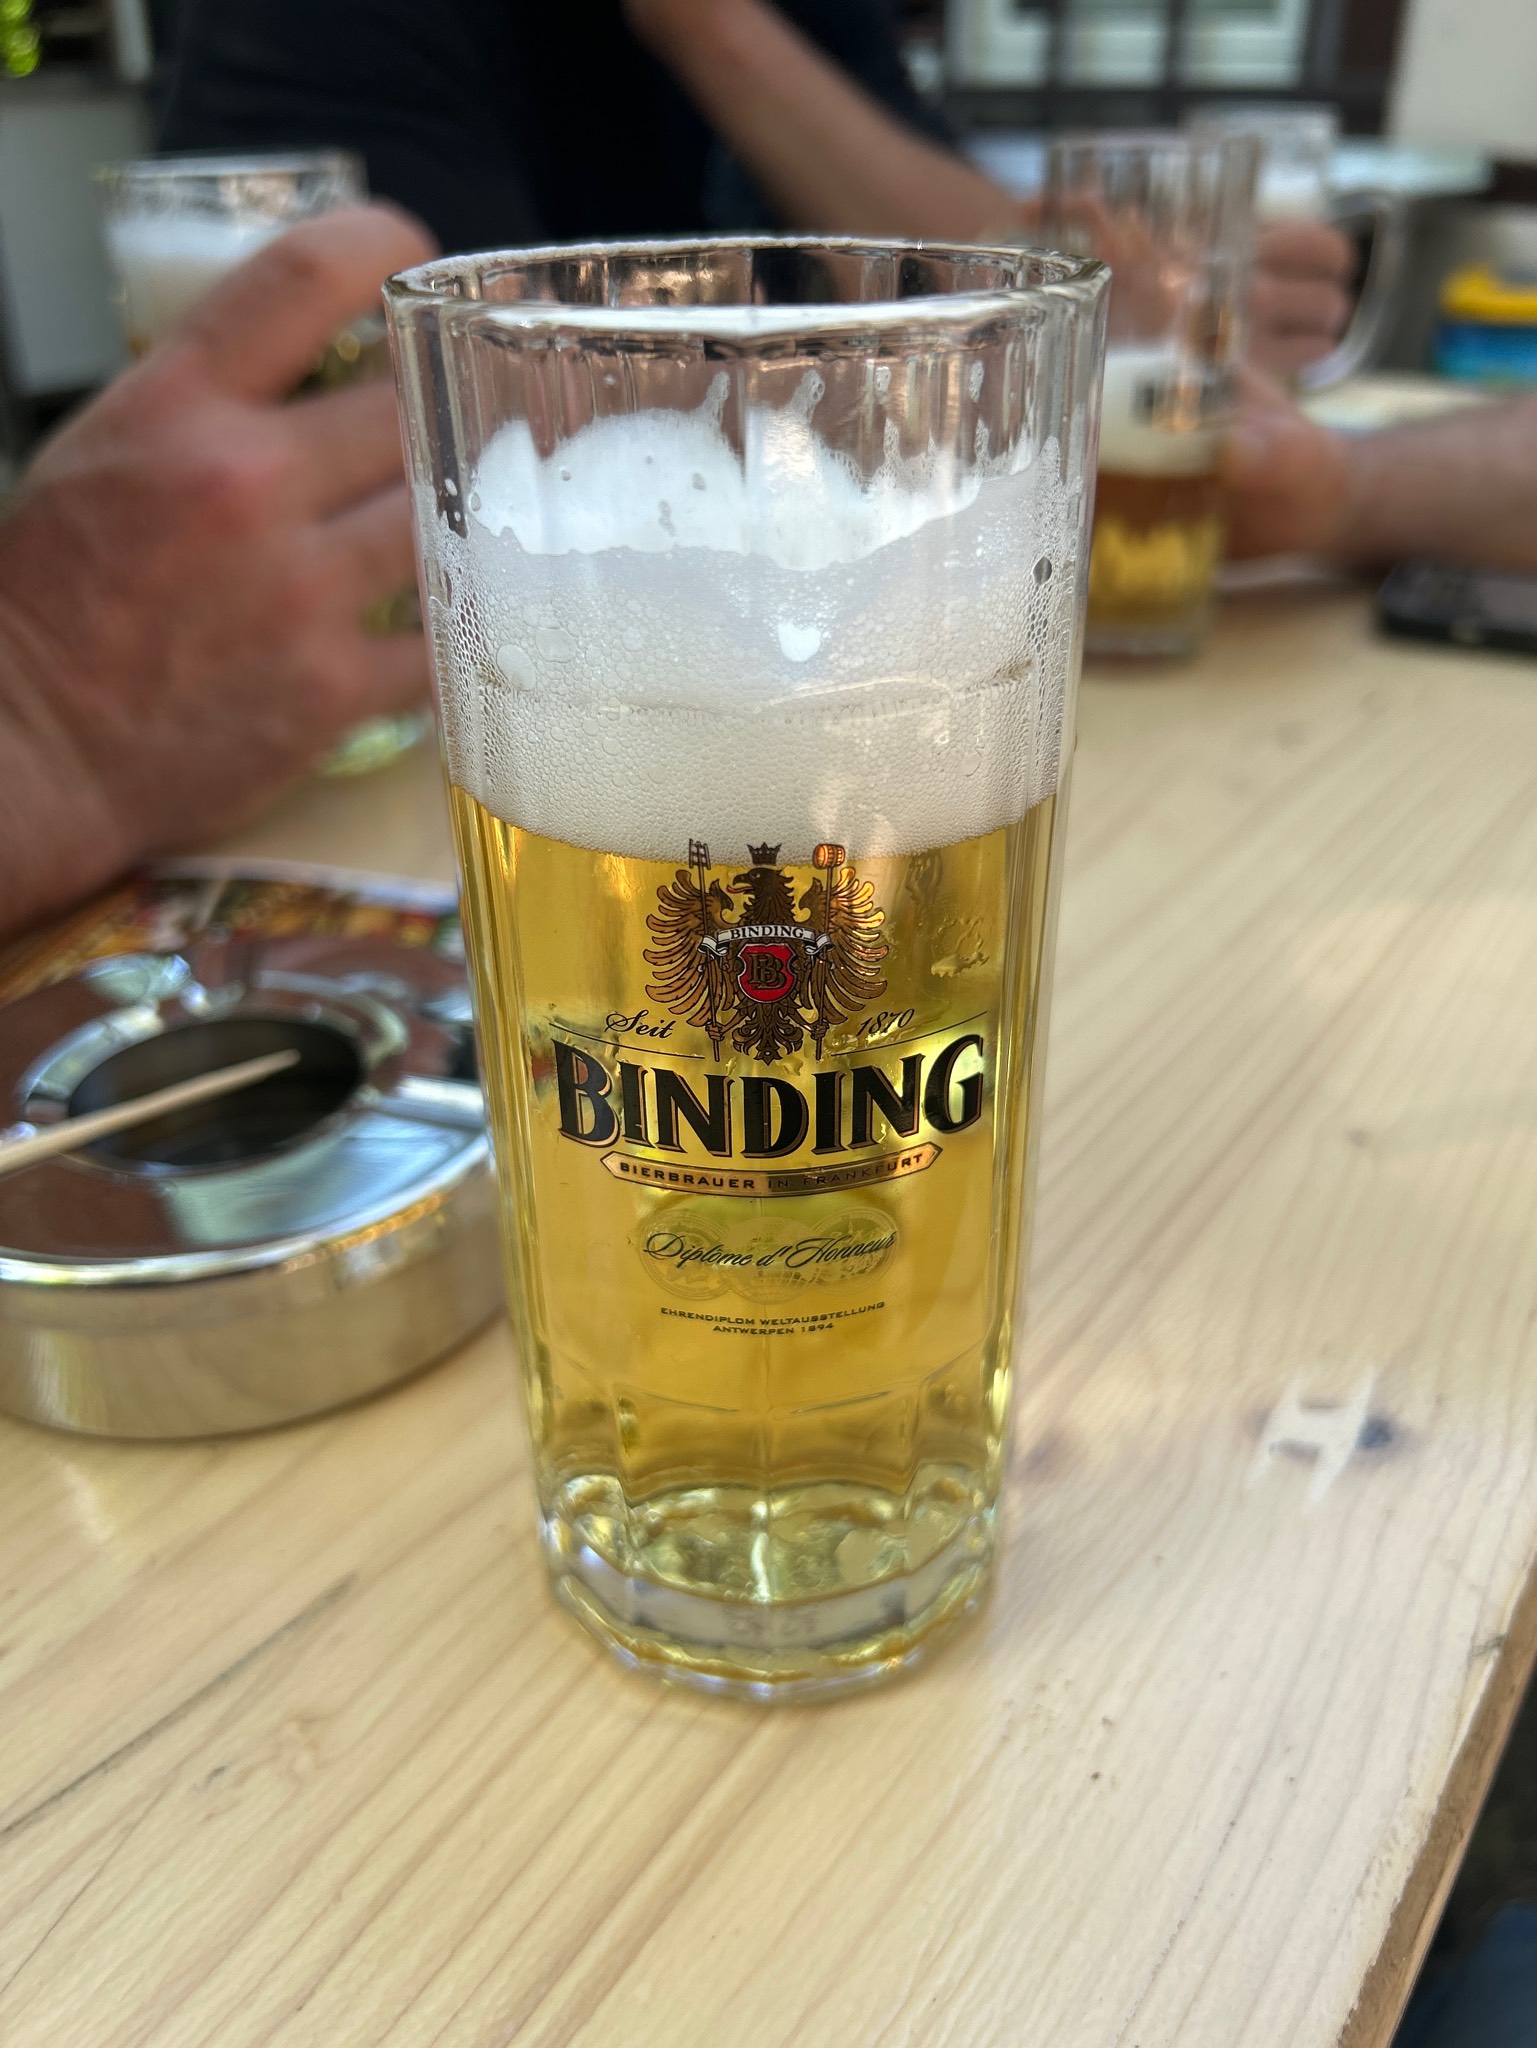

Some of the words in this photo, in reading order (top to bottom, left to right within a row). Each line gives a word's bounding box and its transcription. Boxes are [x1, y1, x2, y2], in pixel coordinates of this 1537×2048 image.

[730, 925, 804, 940] BINDING
[605, 1010, 675, 1039] Seit
[854, 1008, 915, 1037] 1870
[551, 1033, 985, 1158] BINDING
[619, 1161, 756, 1190] BIERBRAUER
[767, 1179, 789, 1189] IN
[802, 1153, 923, 1187] FRANKFURT
[660, 1307, 755, 1326] EHRENDIPLOM
[759, 1301, 886, 1326] WELTAUSSTELLUNG
[712, 1325, 795, 1335] ANTWERPEN
[801, 1322, 835, 1333] 1894
